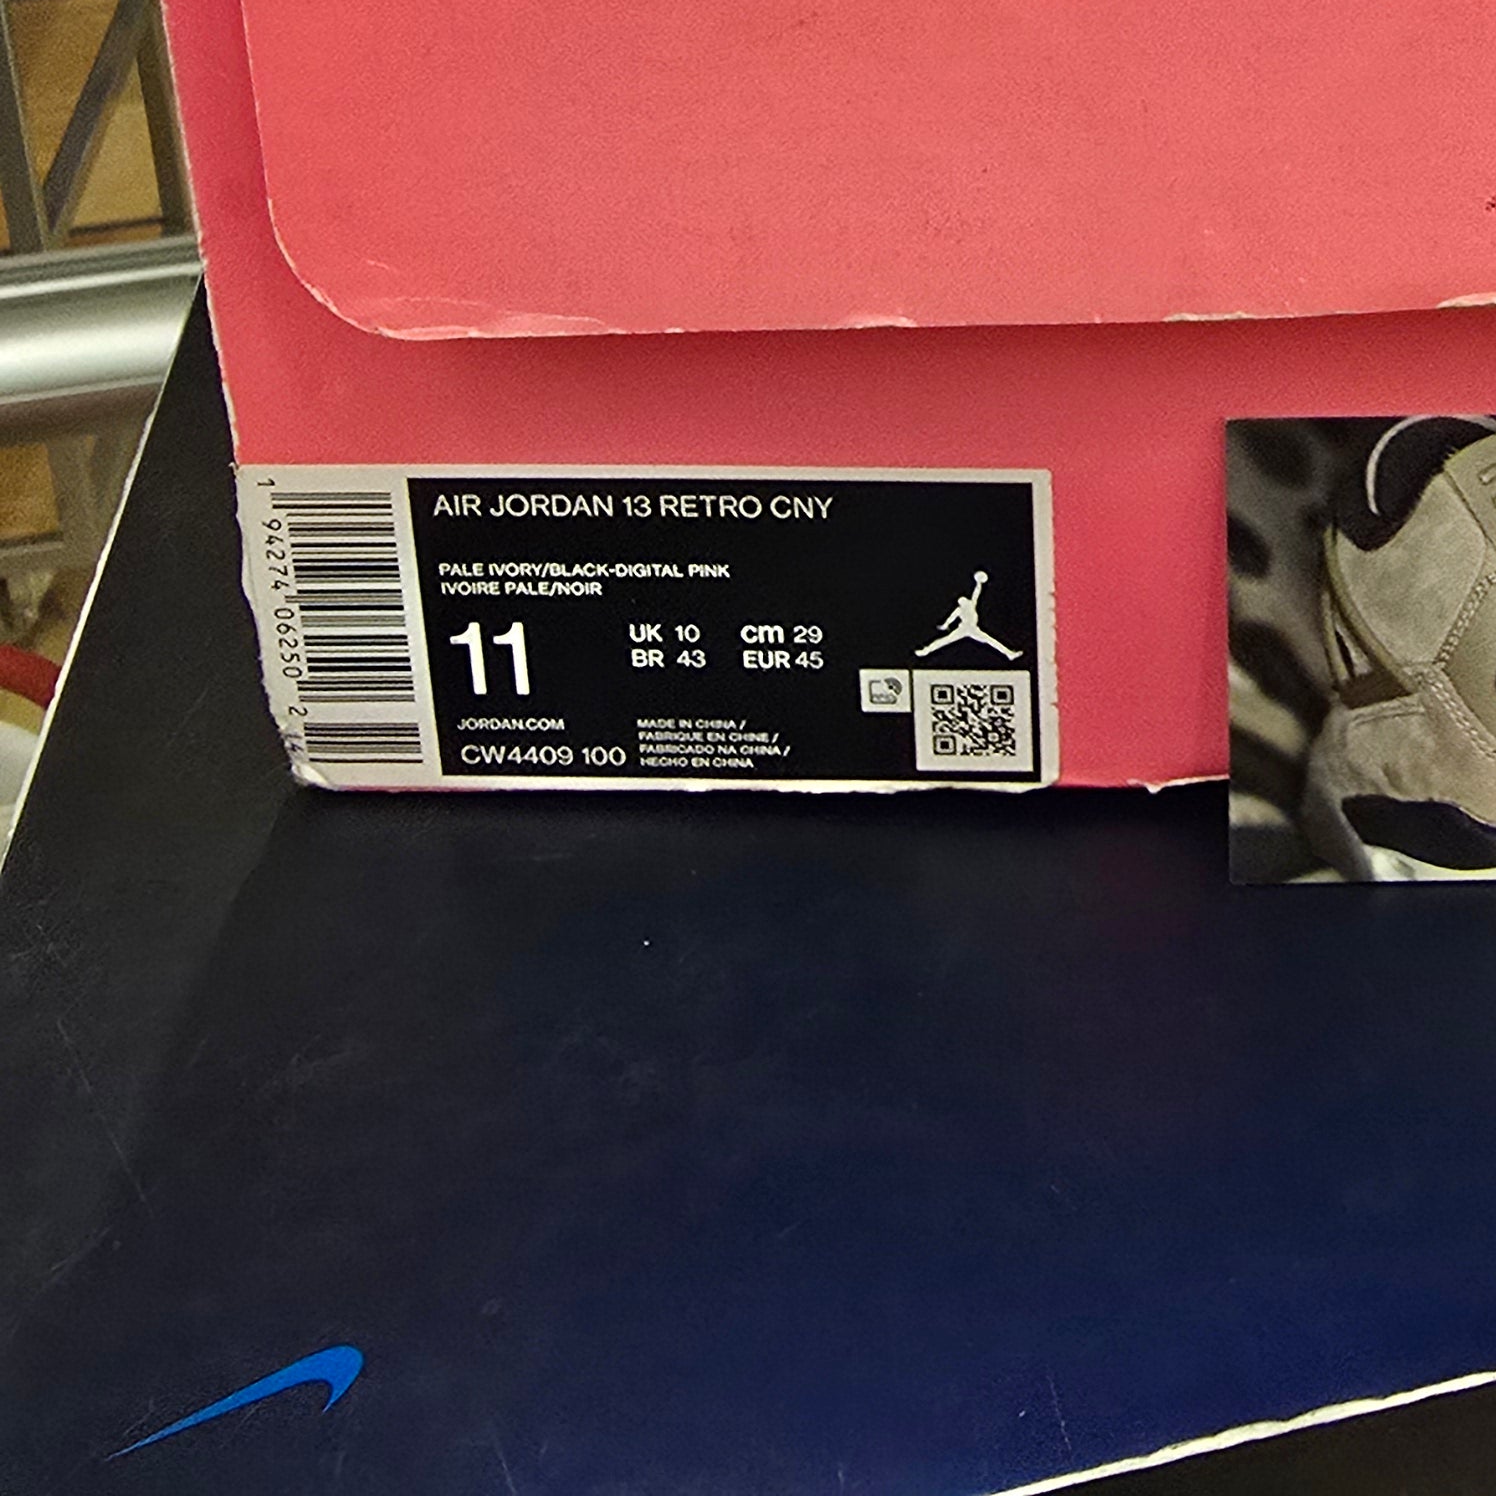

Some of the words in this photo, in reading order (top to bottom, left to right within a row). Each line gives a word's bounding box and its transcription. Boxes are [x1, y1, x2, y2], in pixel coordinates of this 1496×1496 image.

[434, 495, 481, 516] AIR
[490, 494, 613, 517] JORDAN
[622, 495, 651, 517] 13
[661, 495, 762, 518] RETRO
[771, 496, 833, 519] CNY
[261, 519, 288, 590] 94274
[439, 563, 483, 577] PALE
[488, 563, 683, 578] IVORY/BLACK-DIGITAL
[688, 564, 731, 578] PINK
[441, 582, 500, 595] IVOIRE
[505, 582, 603, 596] PALE/NOIR
[629, 624, 663, 643] UK
[675, 624, 700, 643] 10
[740, 624, 785, 643] cm
[793, 625, 823, 643] 29
[274, 607, 303, 679] 06250
[449, 621, 530, 696] 11
[631, 650, 665, 668] BR
[676, 650, 706, 669] 43
[743, 651, 790, 669] EUR
[795, 651, 824, 669] 45
[457, 718, 565, 731] JORDAN.COM
[637, 719, 676, 728] MADE
[679, 719, 692, 728] IN
[695, 720, 736, 729] CHINA
[638, 731, 704, 742] FABRIQUE
[707, 732, 725, 742] EN
[729, 732, 769, 743] CHINE
[461, 744, 574, 766] CW4409
[582, 745, 626, 767] 100
[639, 744, 715, 754] FABRICADO
[717, 744, 737, 754] NA
[740, 745, 781, 755] CHINA
[640, 757, 688, 767] HECHO
[691, 758, 709, 767] EN
[712, 758, 754, 768] CHINA
